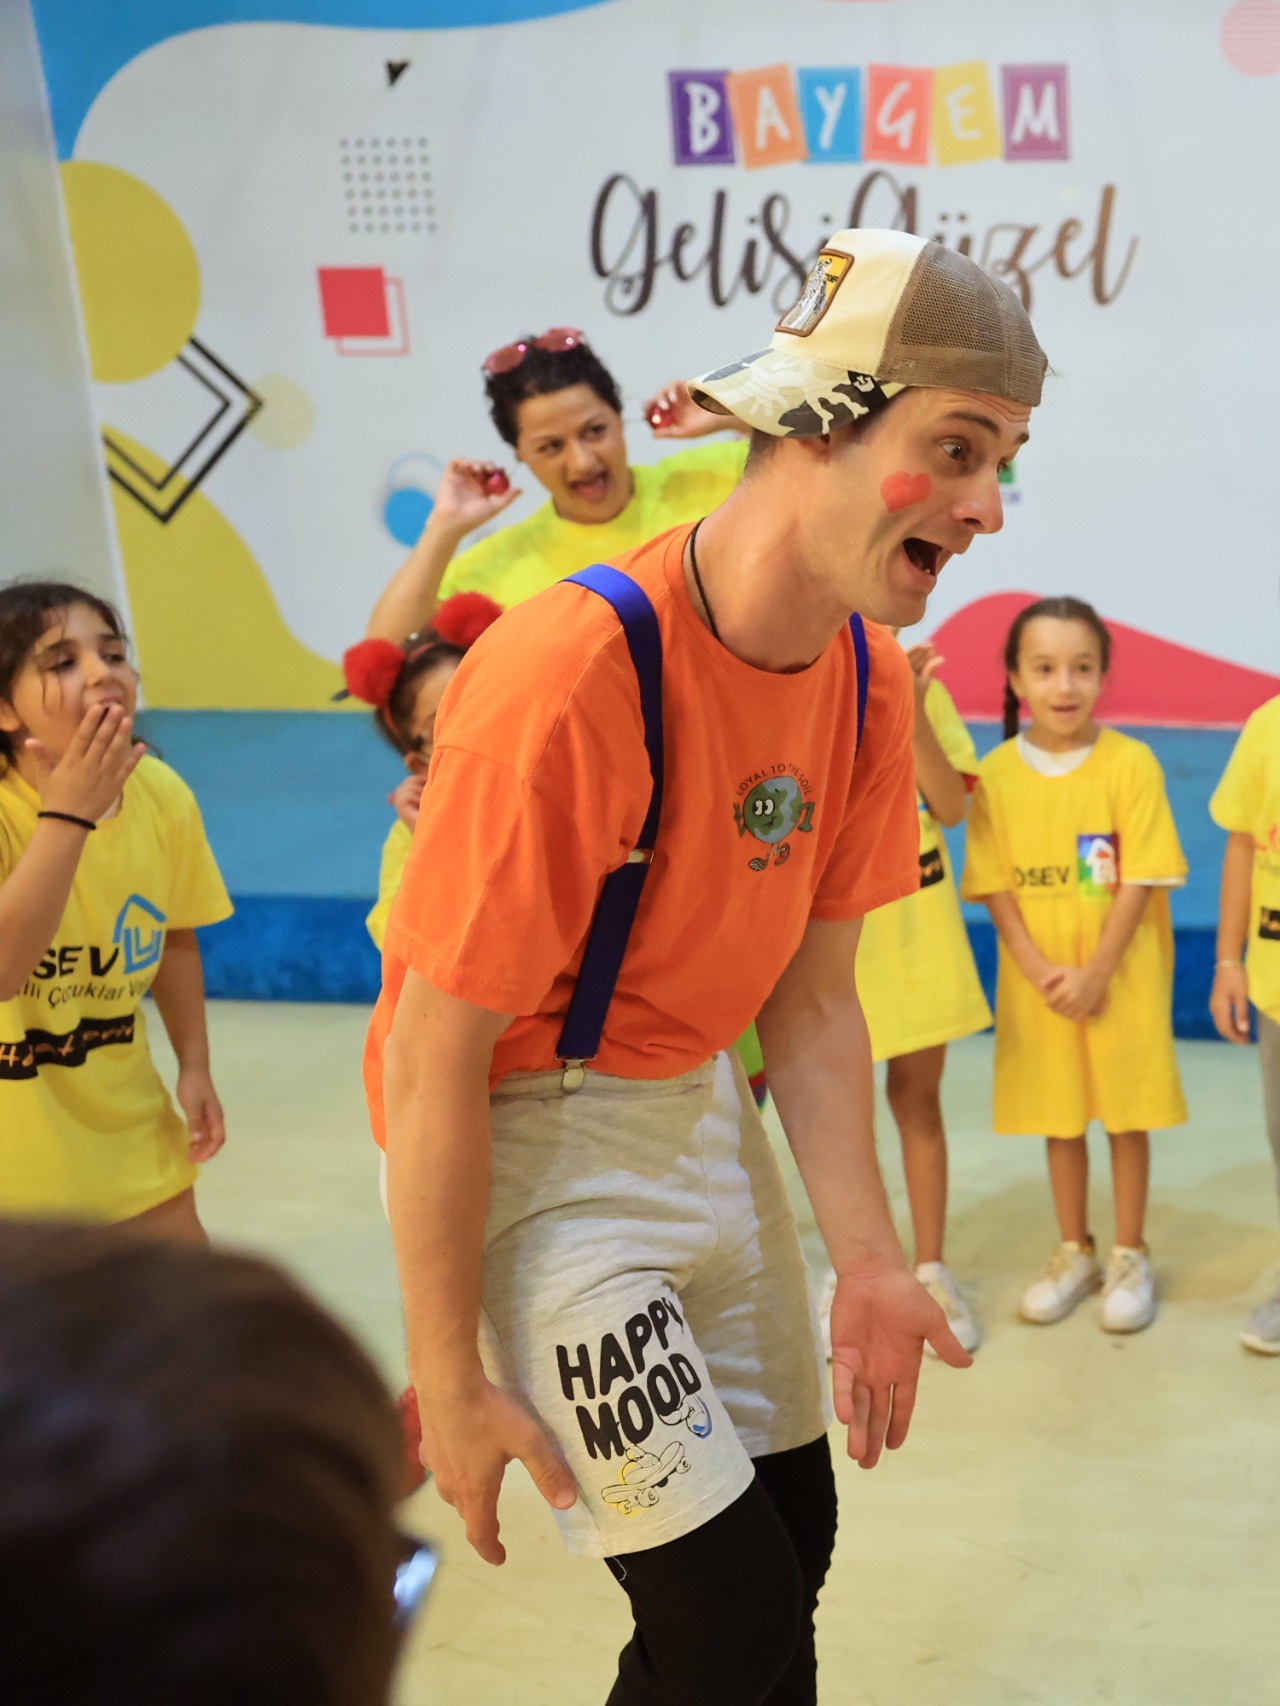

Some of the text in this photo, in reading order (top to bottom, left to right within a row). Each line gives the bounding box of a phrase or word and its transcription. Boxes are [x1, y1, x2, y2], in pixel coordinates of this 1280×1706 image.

[683, 79, 1061, 157] BAYGEM
[735, 763, 813, 796] LOYAL TO THE SOIL
[556, 1296, 684, 1400] HAPPY
[576, 1353, 701, 1460] MOOD
